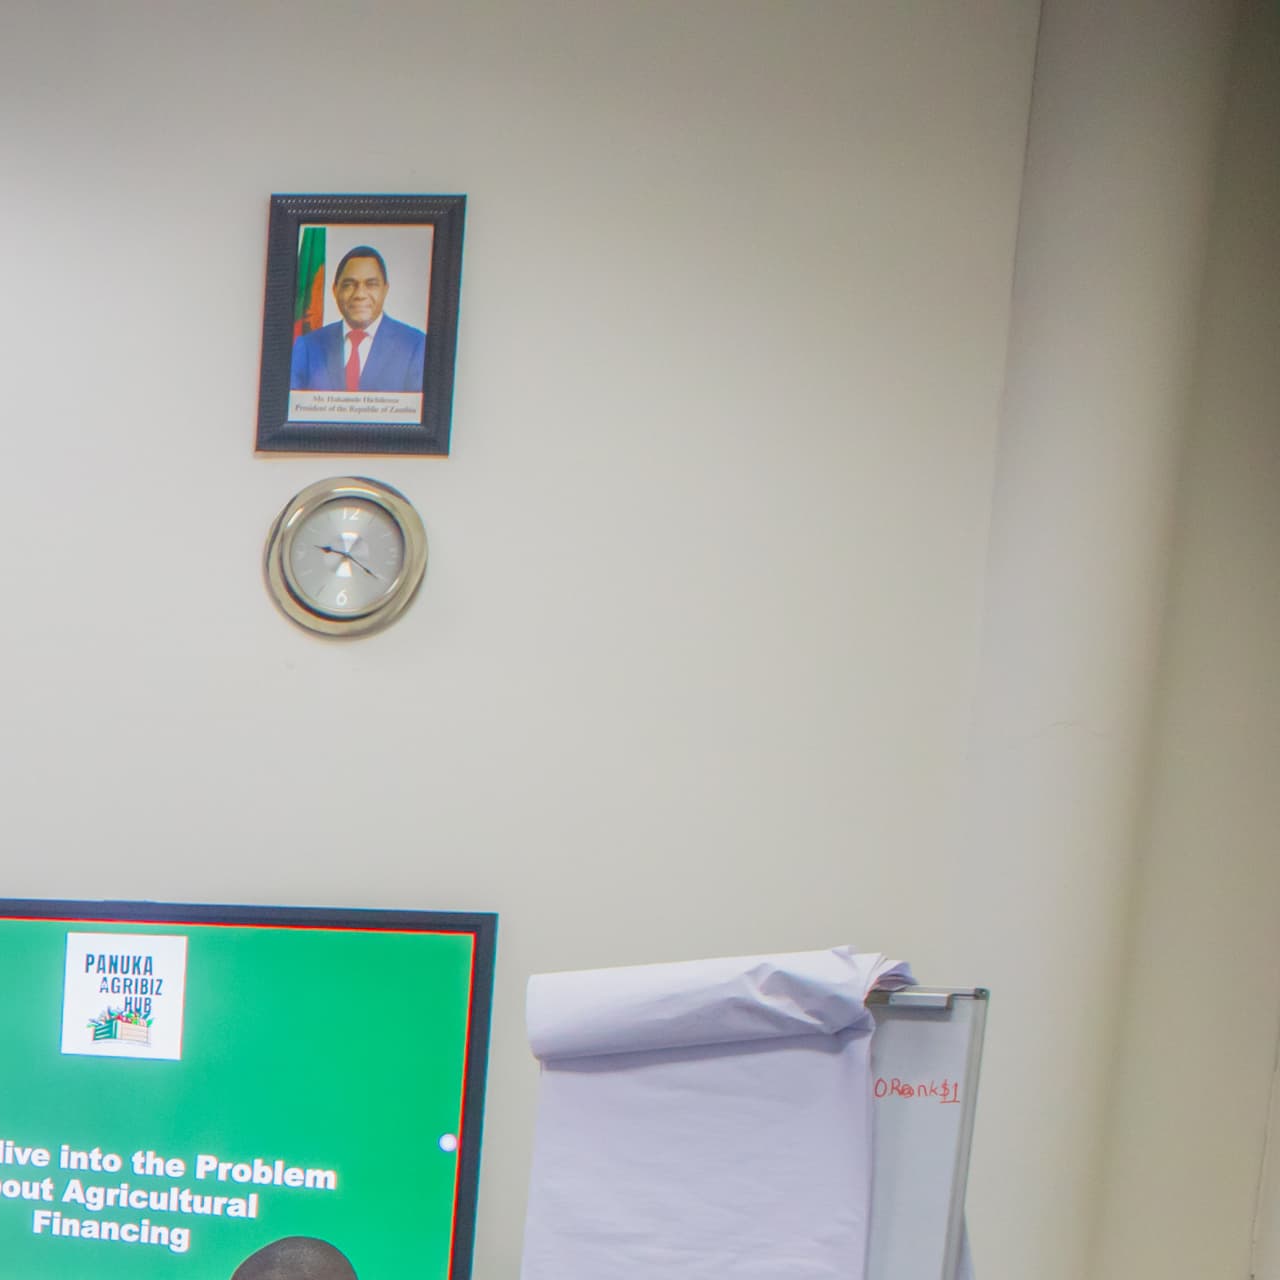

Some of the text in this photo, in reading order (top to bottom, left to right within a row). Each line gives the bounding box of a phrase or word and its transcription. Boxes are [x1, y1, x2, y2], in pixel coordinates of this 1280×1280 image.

[341, 508, 360, 521] 12
[335, 590, 348, 606] 6
[85, 954, 153, 976] PANUKA
[100, 976, 163, 996] AGRIBIZ
[124, 996, 152, 1014] HUB
[60, 1145, 121, 1172] into
[132, 1151, 185, 1178] the
[196, 1154, 337, 1190] Problem
[62, 1179, 257, 1218] Agricultural
[32, 1209, 190, 1253] Financing
